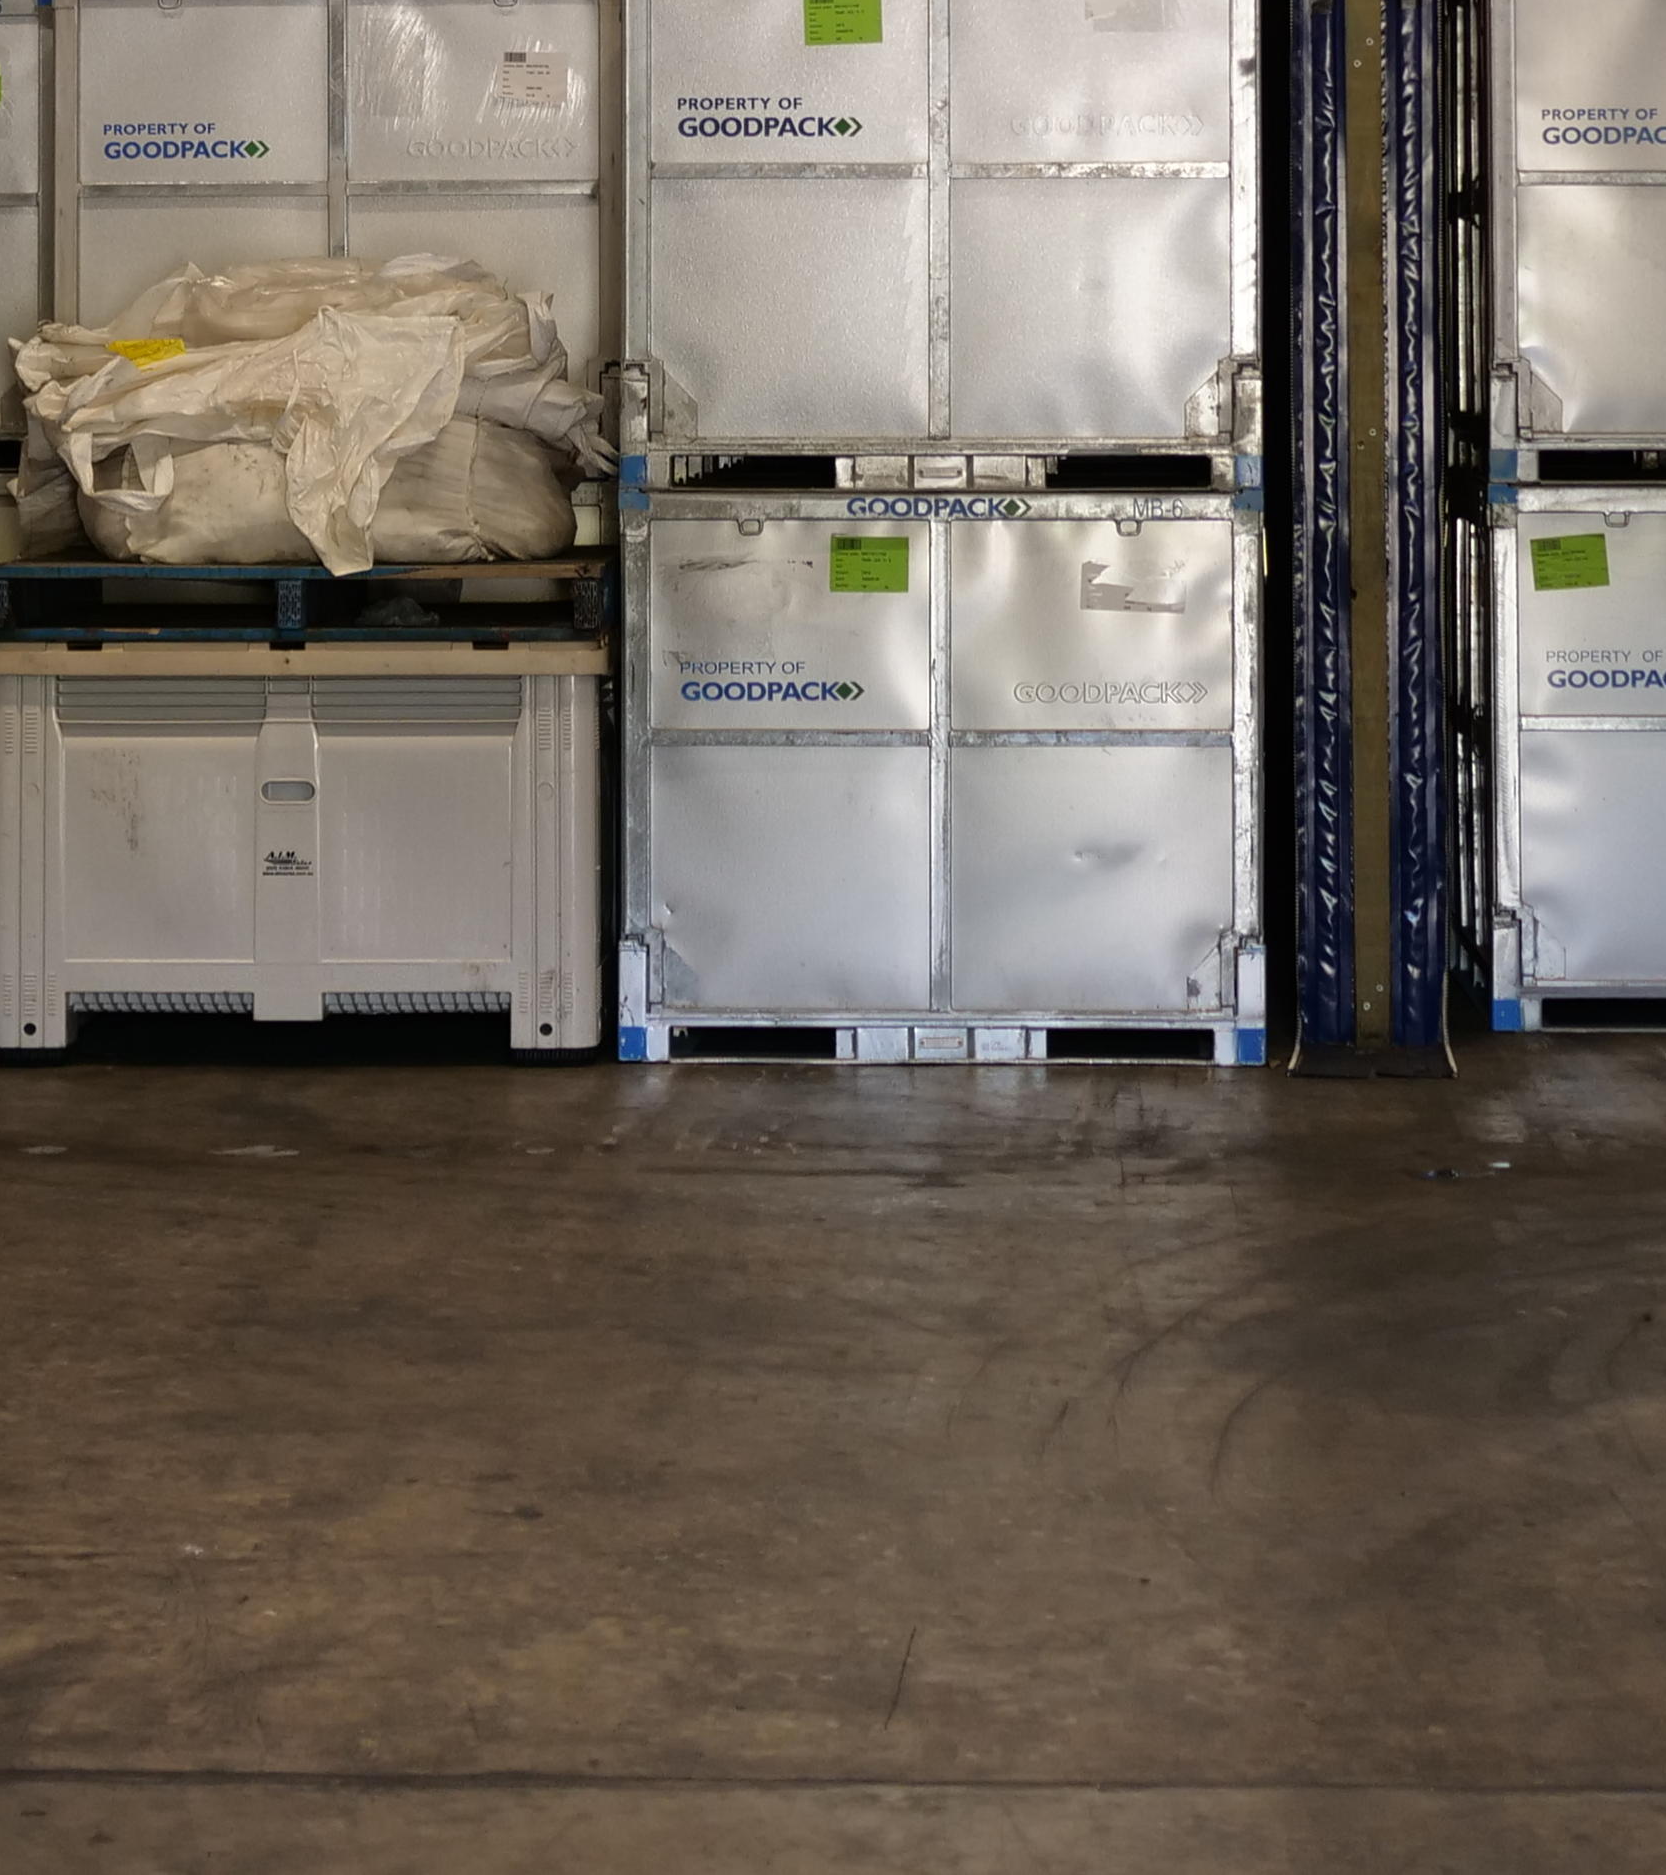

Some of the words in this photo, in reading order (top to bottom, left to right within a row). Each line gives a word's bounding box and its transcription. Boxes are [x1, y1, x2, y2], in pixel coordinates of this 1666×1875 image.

[677, 97, 770, 110] PROPERTY
[778, 97, 803, 109] OF
[1541, 108, 1628, 121] PROPERTY
[1635, 108, 1658, 120] OF
[103, 123, 187, 135] PROPERTY
[193, 123, 215, 135] OF
[677, 117, 835, 137] GOODPACK
[103, 141, 246, 160] GOODPACK
[846, 497, 1003, 517] GOODPACK
[1132, 497, 1184, 518] MB-6
[1545, 650, 1631, 663] PROPERTY
[1642, 650, 1663, 662] OF
[680, 661, 775, 675] PROPERTY
[781, 661, 806, 674] OF
[681, 681, 837, 702] GOODPACK
